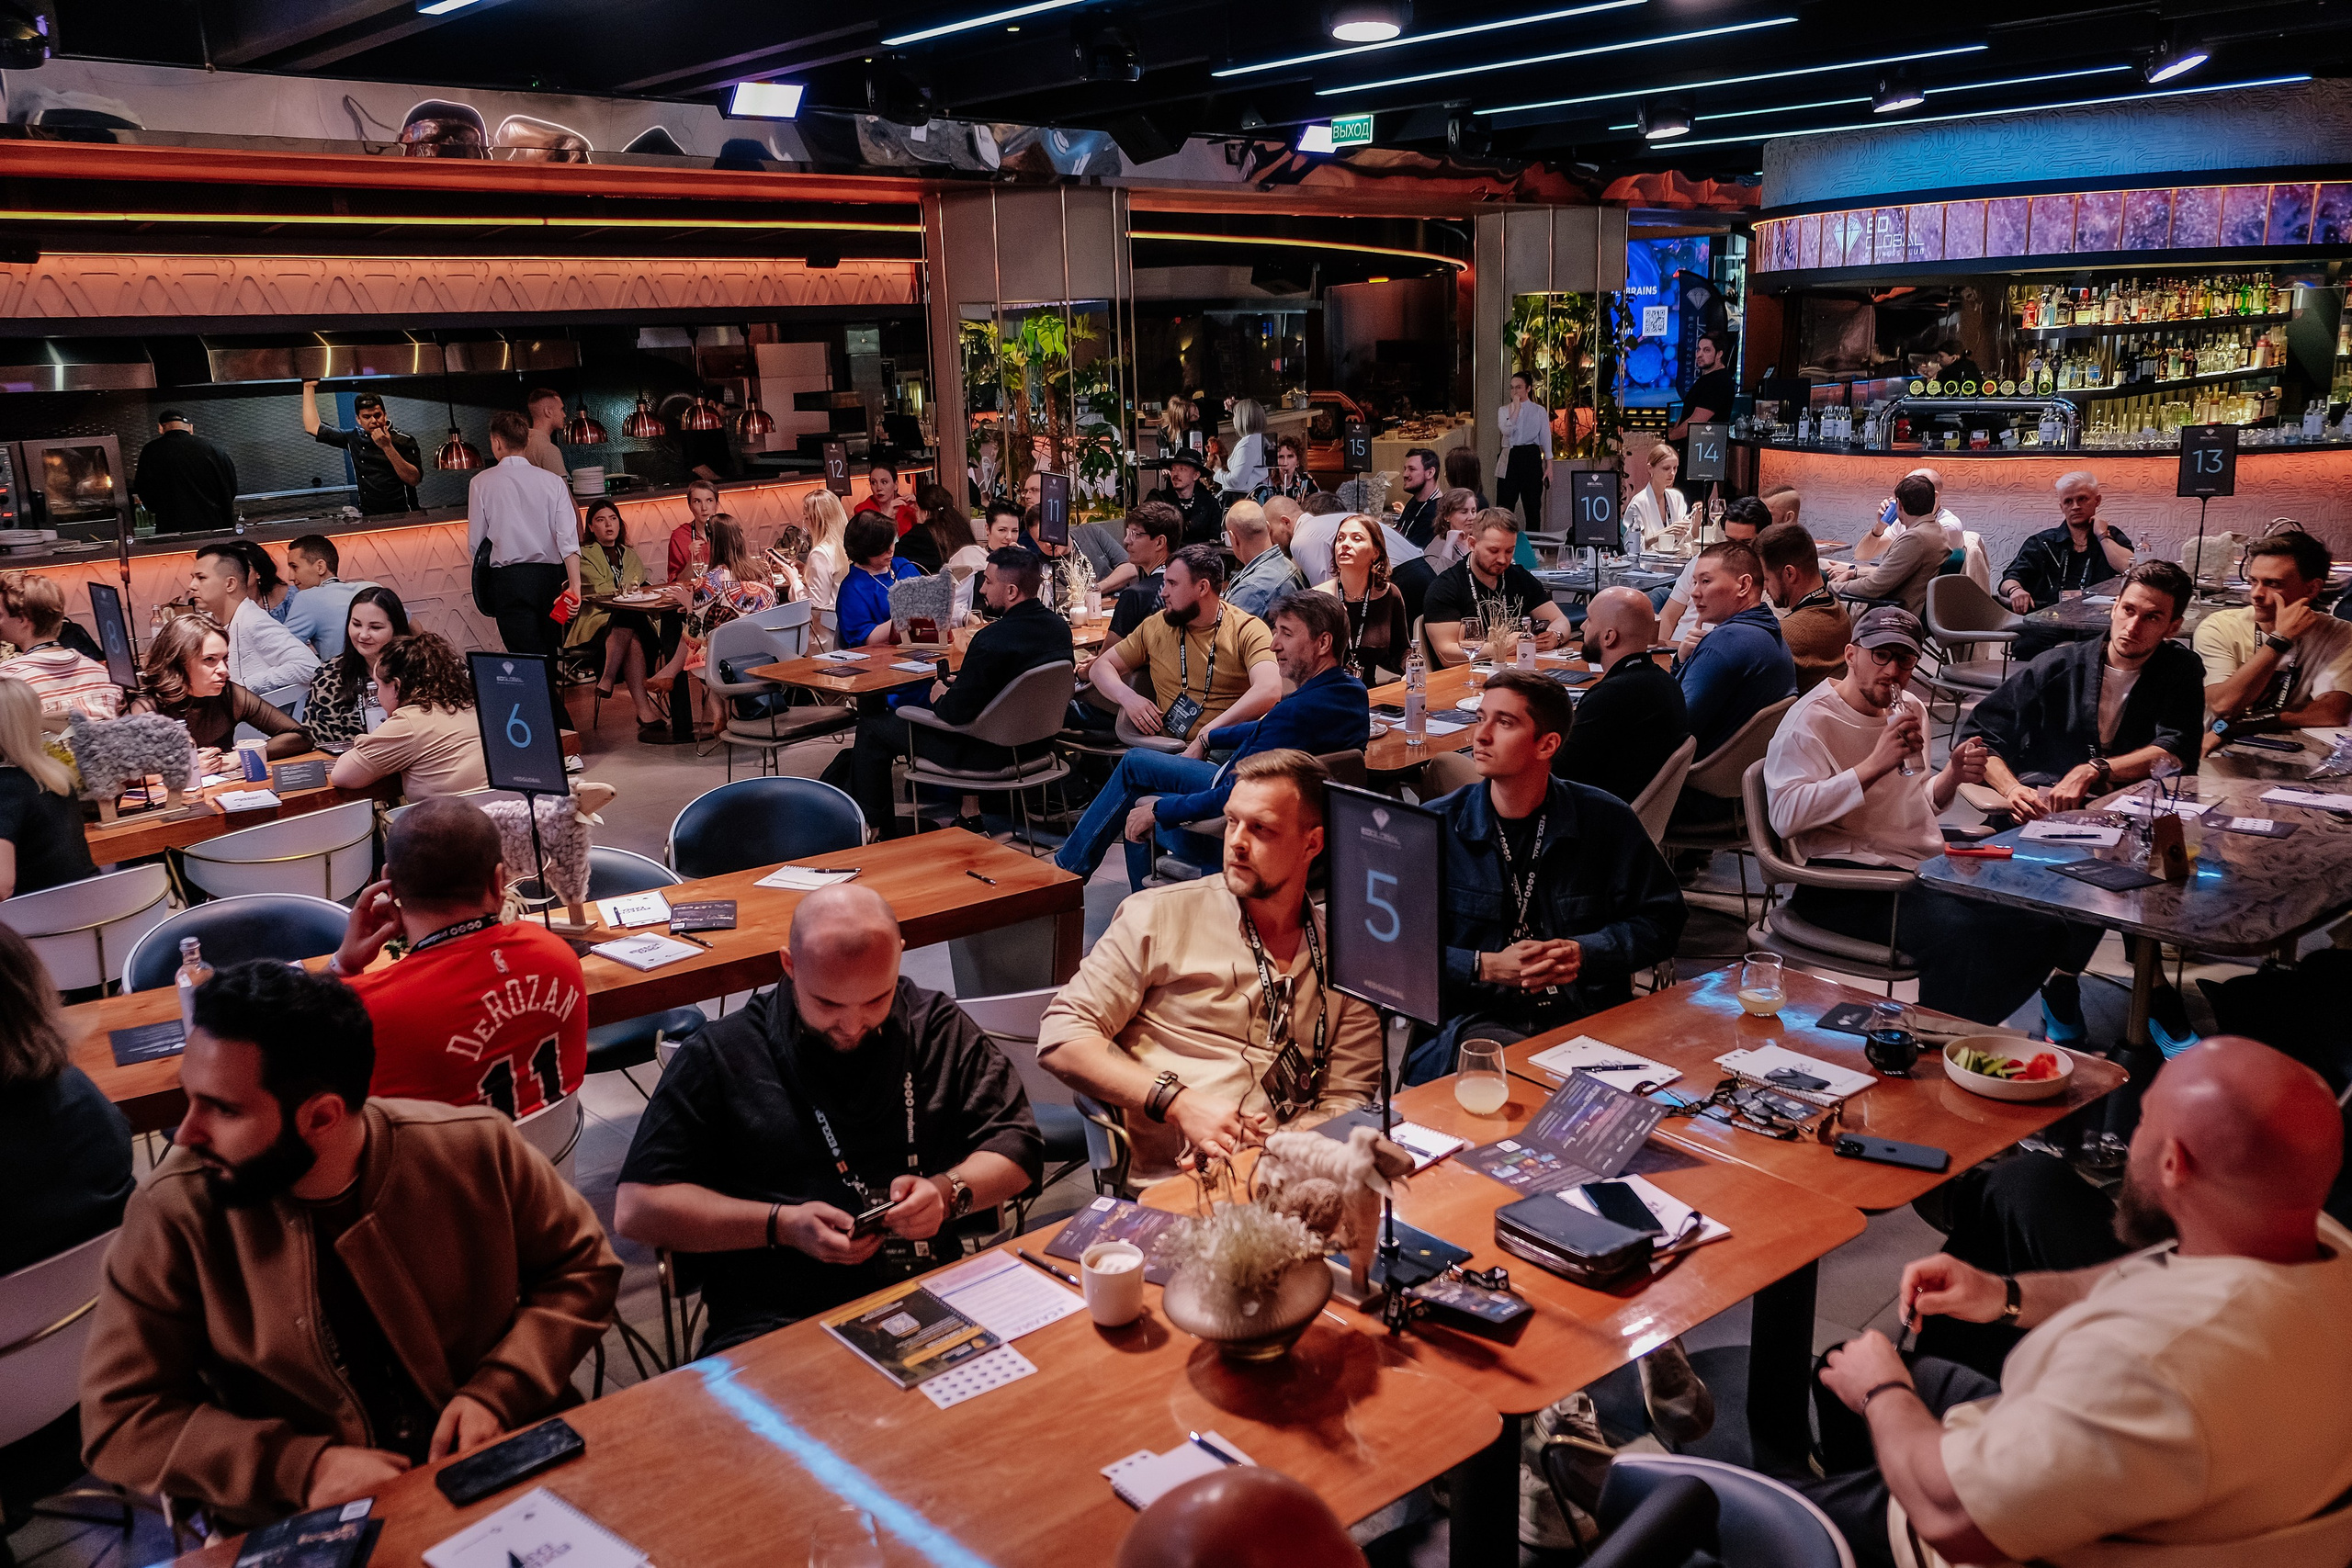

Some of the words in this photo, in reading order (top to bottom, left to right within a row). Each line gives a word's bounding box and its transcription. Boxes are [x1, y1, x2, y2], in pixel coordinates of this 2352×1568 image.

[1332, 122, 1370, 139] ВЫХОД
[1350, 438, 1365, 457] 15
[1695, 442, 1719, 463] 14
[829, 459, 844, 478] 12
[2192, 448, 2223, 474] 13
[1047, 498, 1059, 523] 11
[1580, 496, 1611, 522] 10
[107, 620, 120, 654] 8
[506, 703, 532, 749] 6
[1365, 868, 1401, 942] 5
[446, 974, 580, 1062] DEROZAN
[477, 1031, 568, 1122] 11
